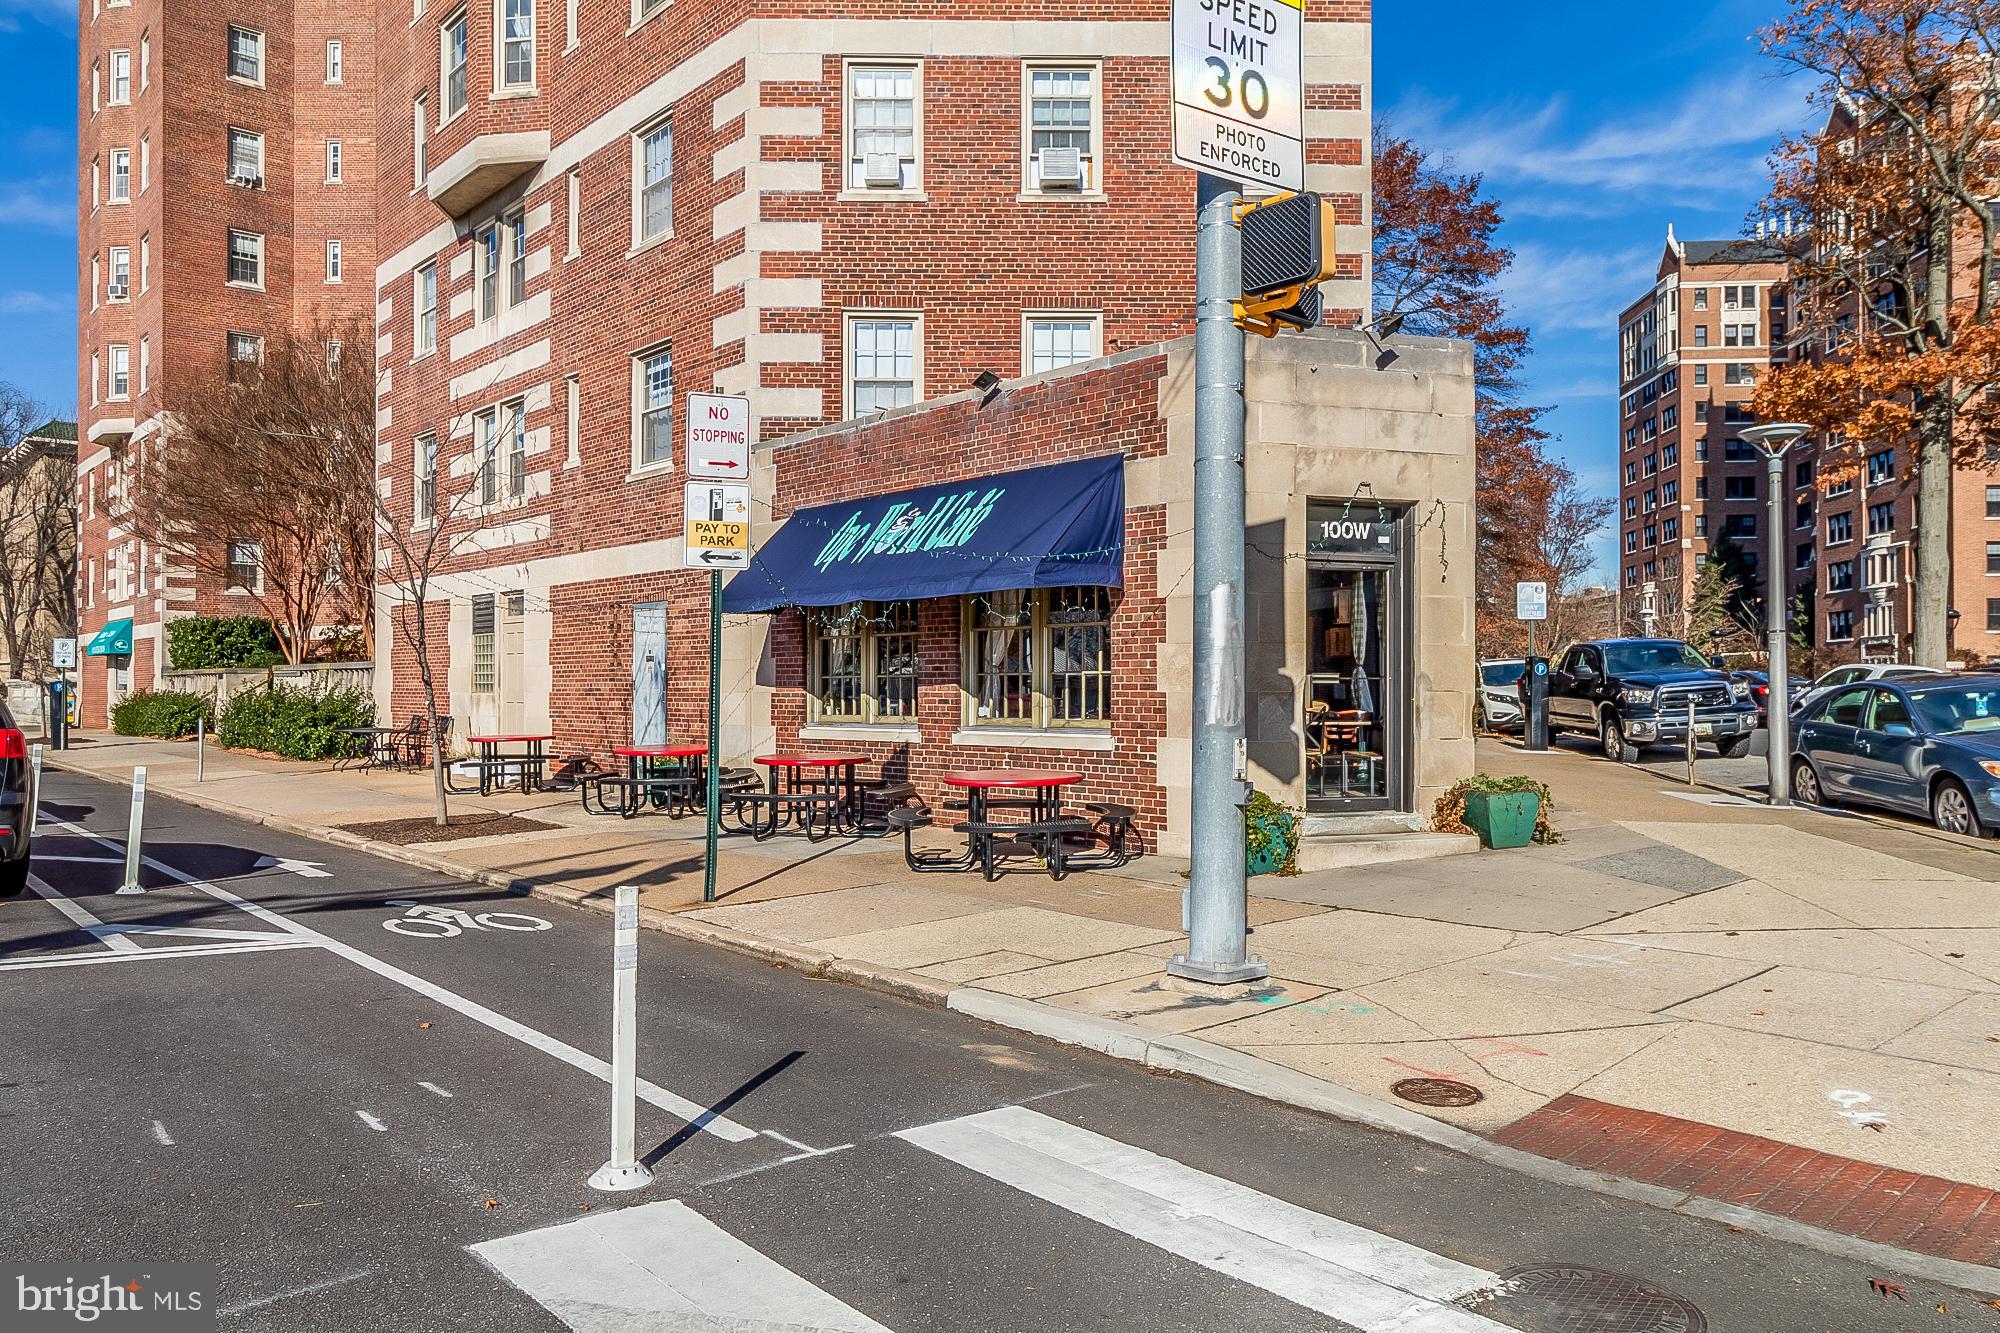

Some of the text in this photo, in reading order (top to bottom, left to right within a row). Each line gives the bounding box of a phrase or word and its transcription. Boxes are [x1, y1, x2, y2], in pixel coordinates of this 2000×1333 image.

[1208, 21, 1268, 66] LIMIT
[1203, 55, 1270, 120] 30
[1216, 123, 1266, 152] PHOTO
[1200, 141, 1281, 178] ENFORCED
[709, 406, 729, 421] NO
[692, 428, 745, 445] STOPPING
[695, 523, 741, 535] PAY TO
[924, 487, 1006, 551] Café
[1320, 521, 1371, 540] 100W
[700, 535, 735, 547] PARK
